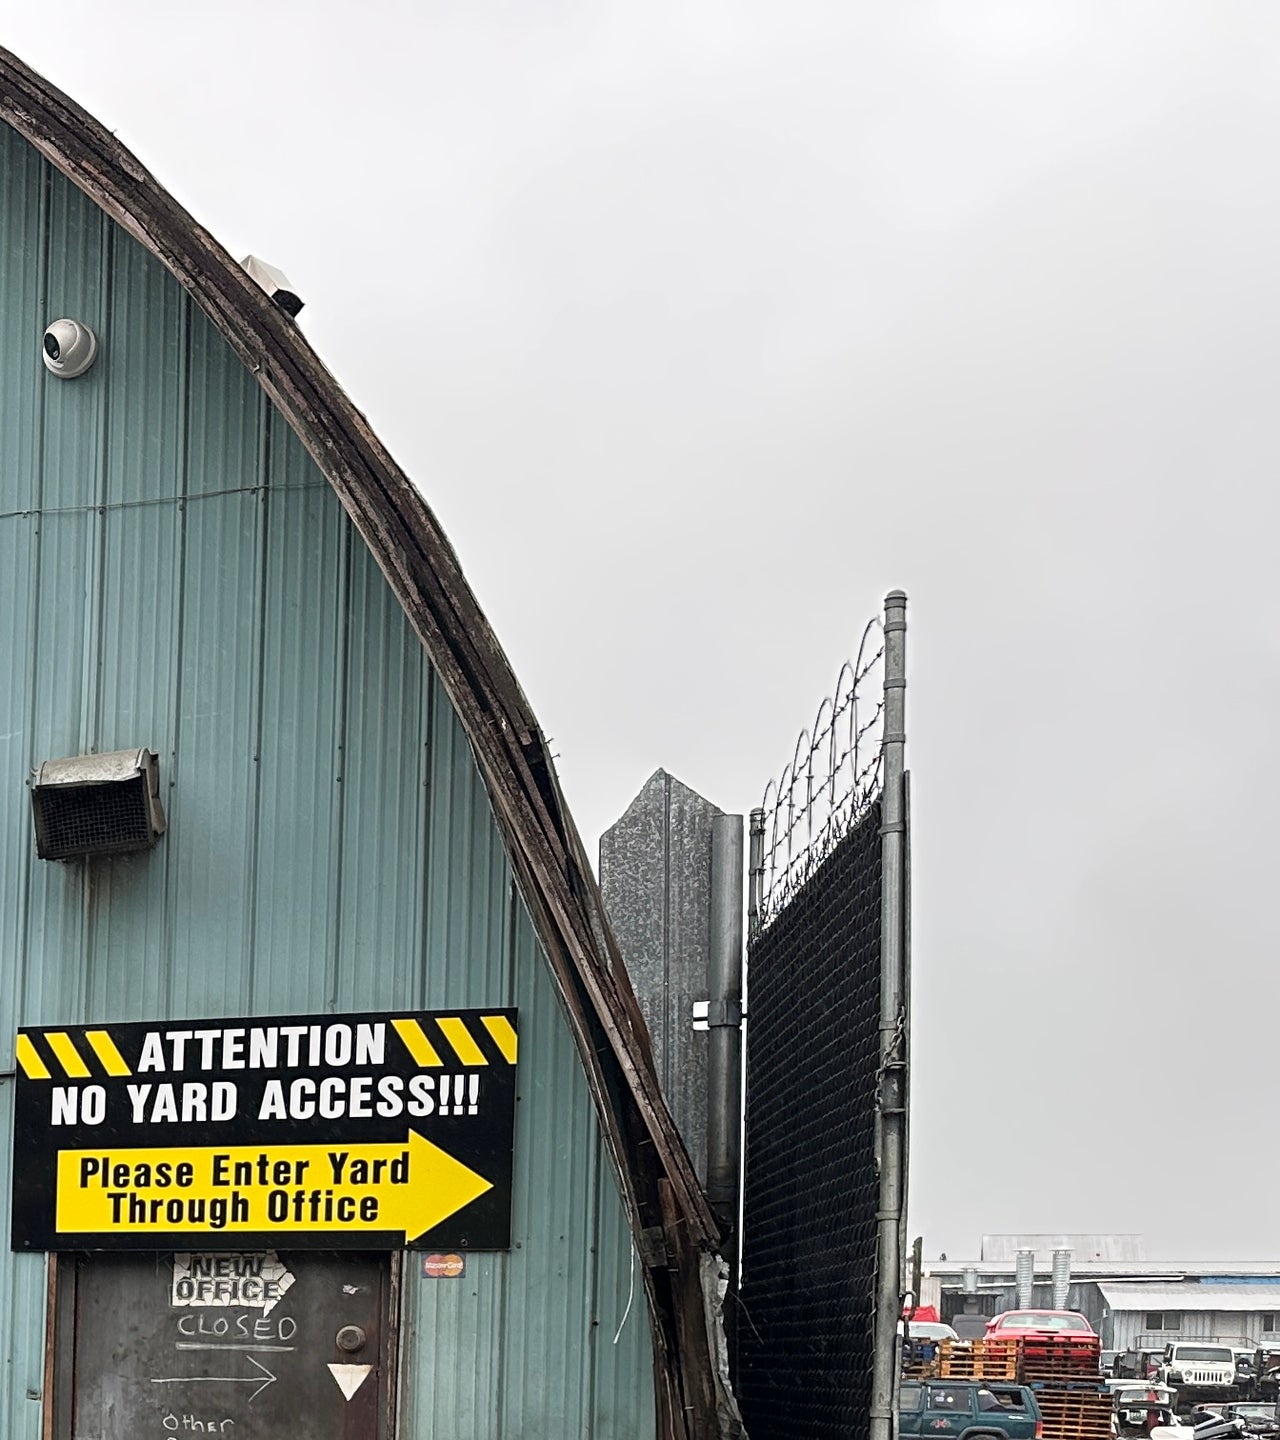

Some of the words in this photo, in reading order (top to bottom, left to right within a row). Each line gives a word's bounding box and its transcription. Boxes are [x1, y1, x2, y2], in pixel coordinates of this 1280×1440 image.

[137, 1023, 386, 1073] ATTENTION
[50, 1085, 107, 1126] NO
[129, 1081, 238, 1124] YARD
[258, 1074, 480, 1121] ACCESS!!!
[79, 1156, 194, 1189] Please
[212, 1154, 310, 1187] Enter
[328, 1151, 410, 1184] Yard
[107, 1189, 250, 1229] Through
[267, 1188, 379, 1222] Office
[190, 1256, 265, 1278] NEW
[176, 1277, 280, 1301] OFFICE
[177, 1313, 297, 1341] CLOSED
